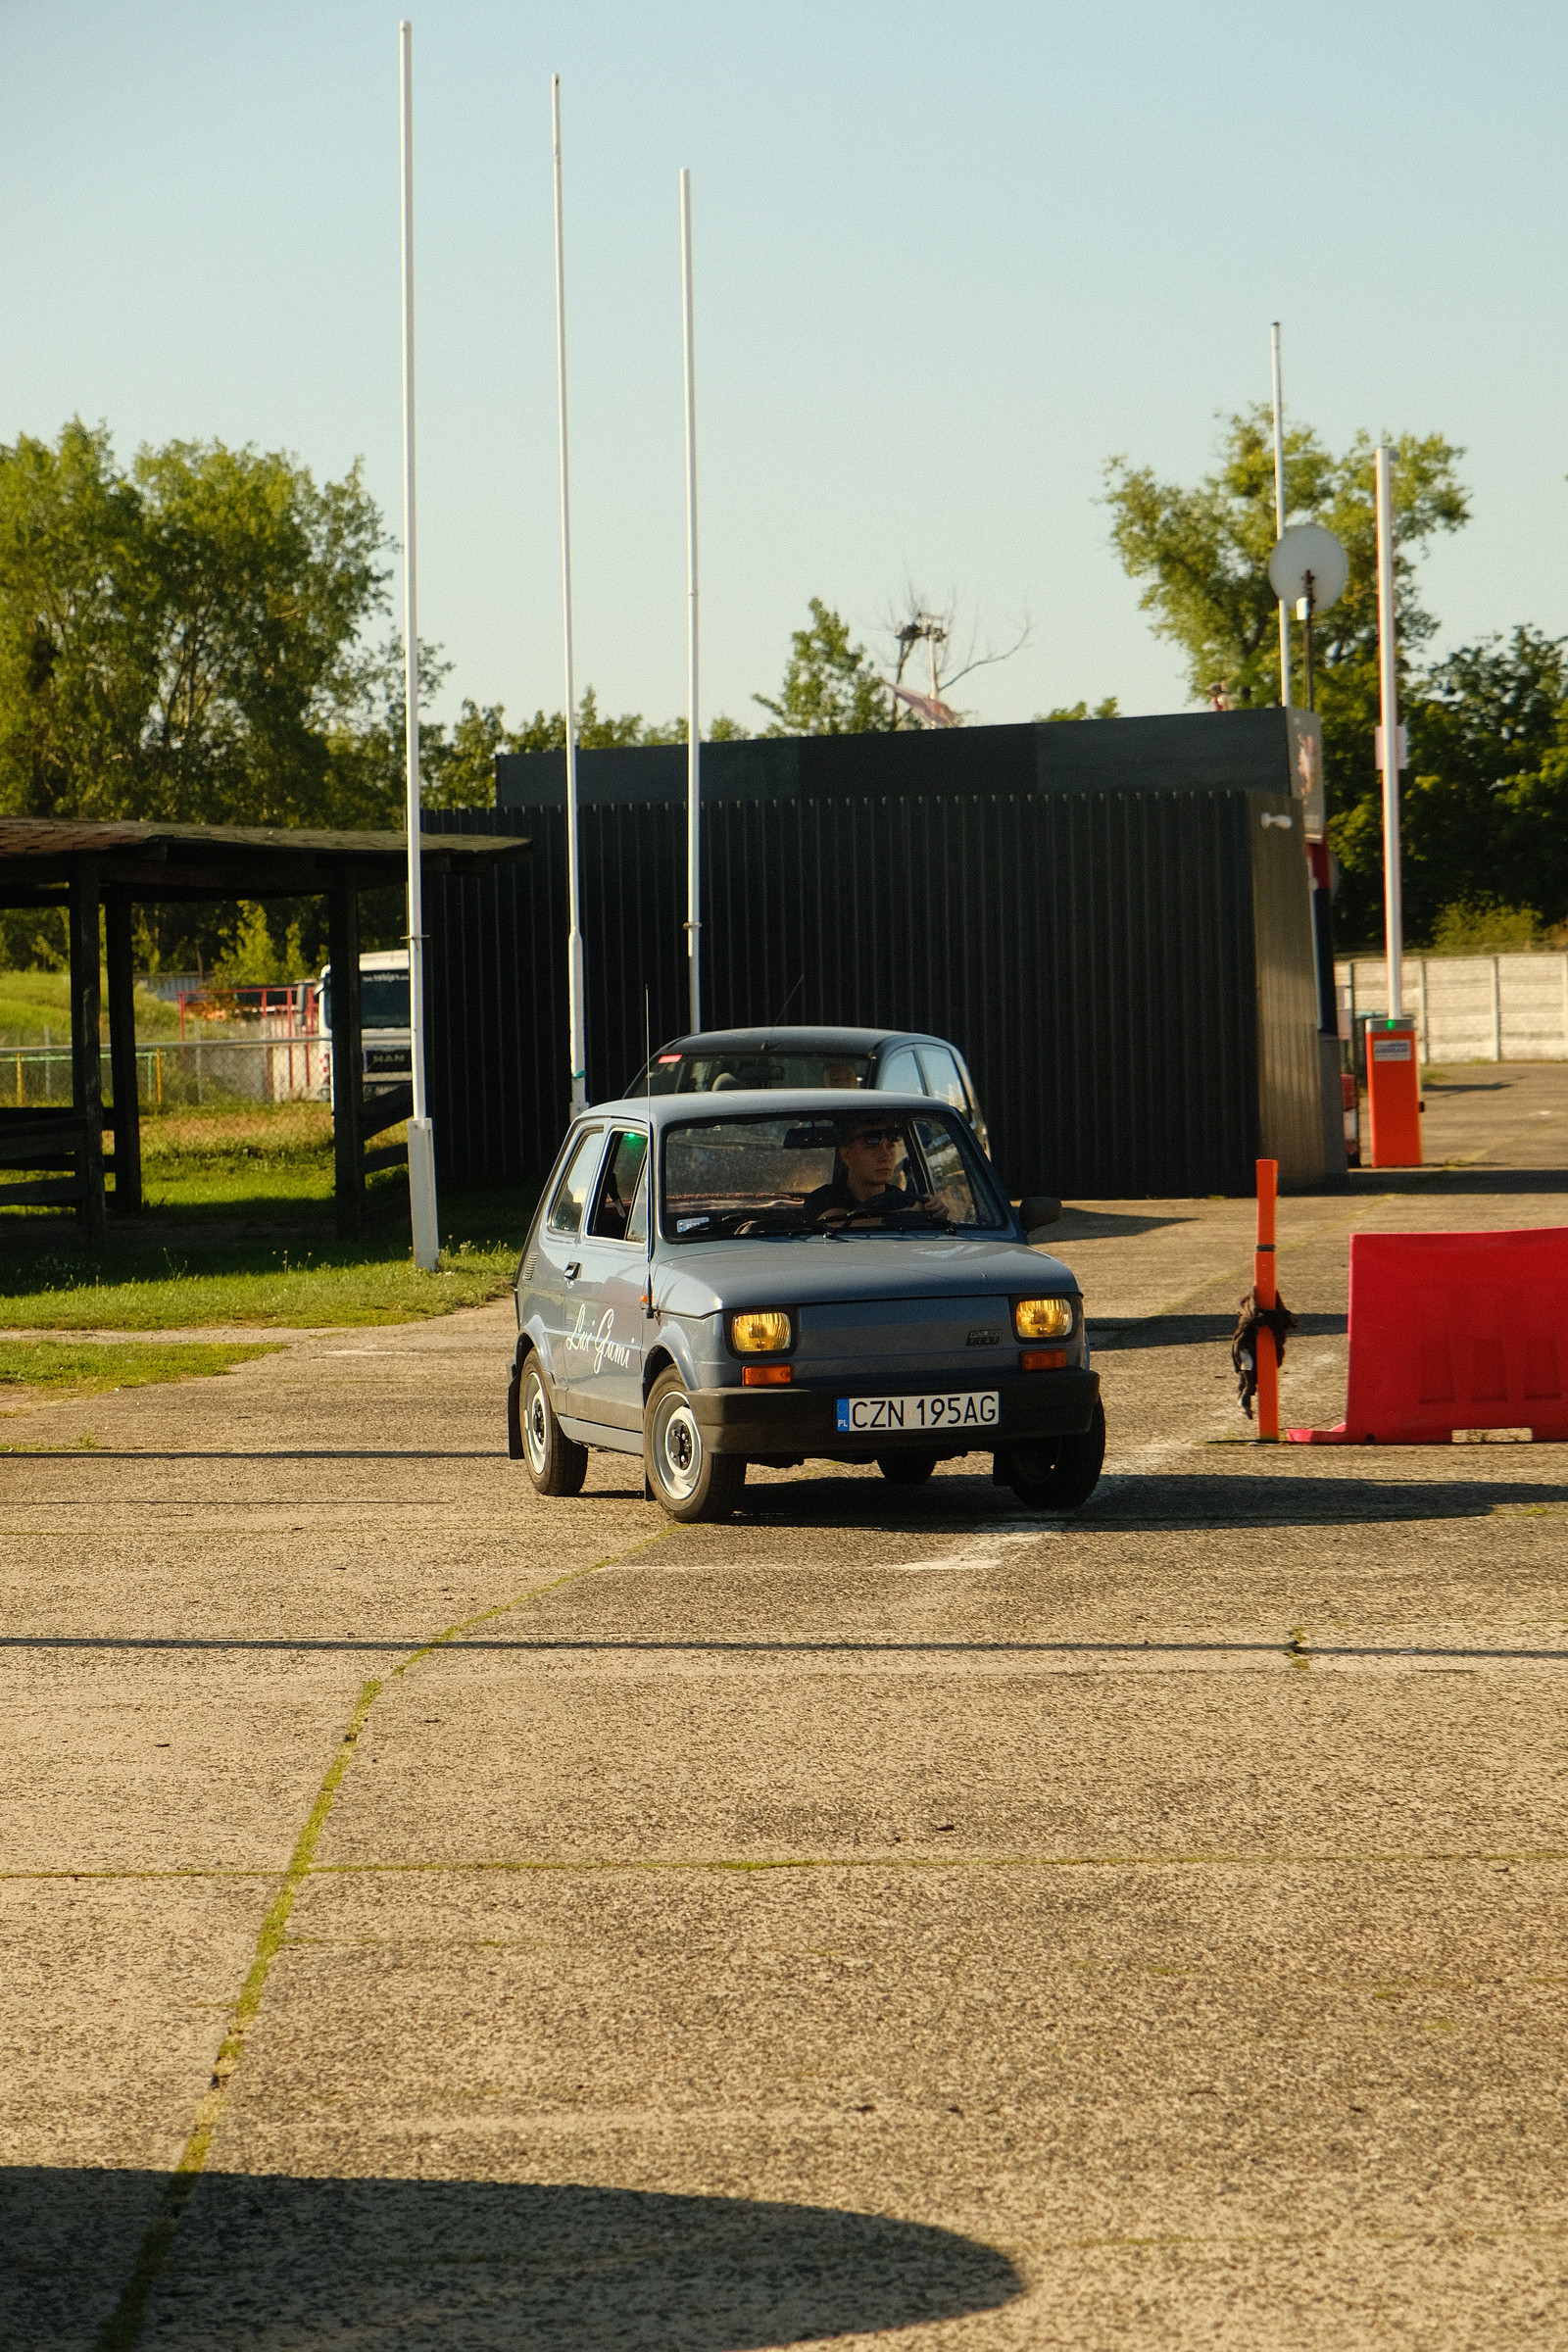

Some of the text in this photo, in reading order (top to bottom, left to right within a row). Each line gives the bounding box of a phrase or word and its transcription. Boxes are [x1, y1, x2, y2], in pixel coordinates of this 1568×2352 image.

[852, 1395, 996, 1428] CZN 195AG
[837, 1419, 848, 1428] PL
